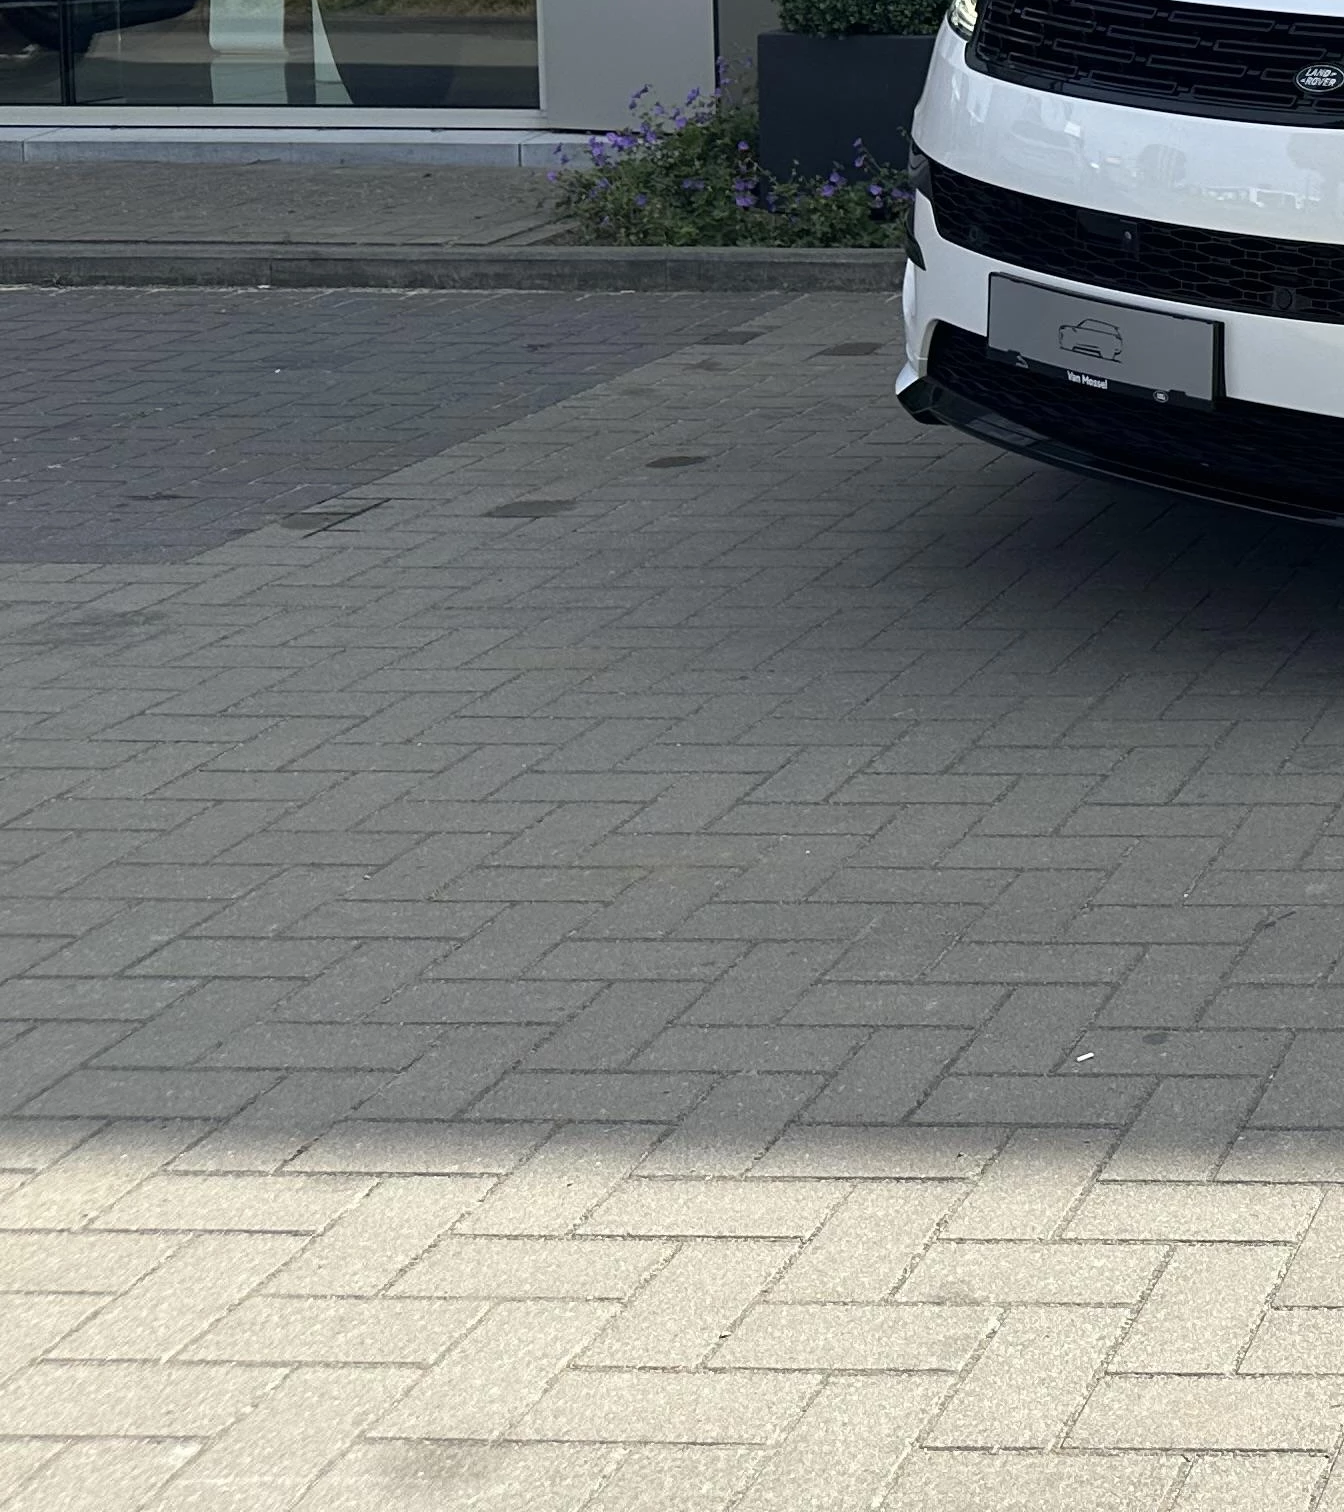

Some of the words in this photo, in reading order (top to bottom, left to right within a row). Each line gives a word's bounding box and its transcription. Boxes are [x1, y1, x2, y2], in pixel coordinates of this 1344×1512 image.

[1304, 67, 1332, 78] LAND
[1304, 76, 1338, 87] ROVER
[1066, 370, 1082, 384] Van
[1082, 374, 1109, 391] Mossel
